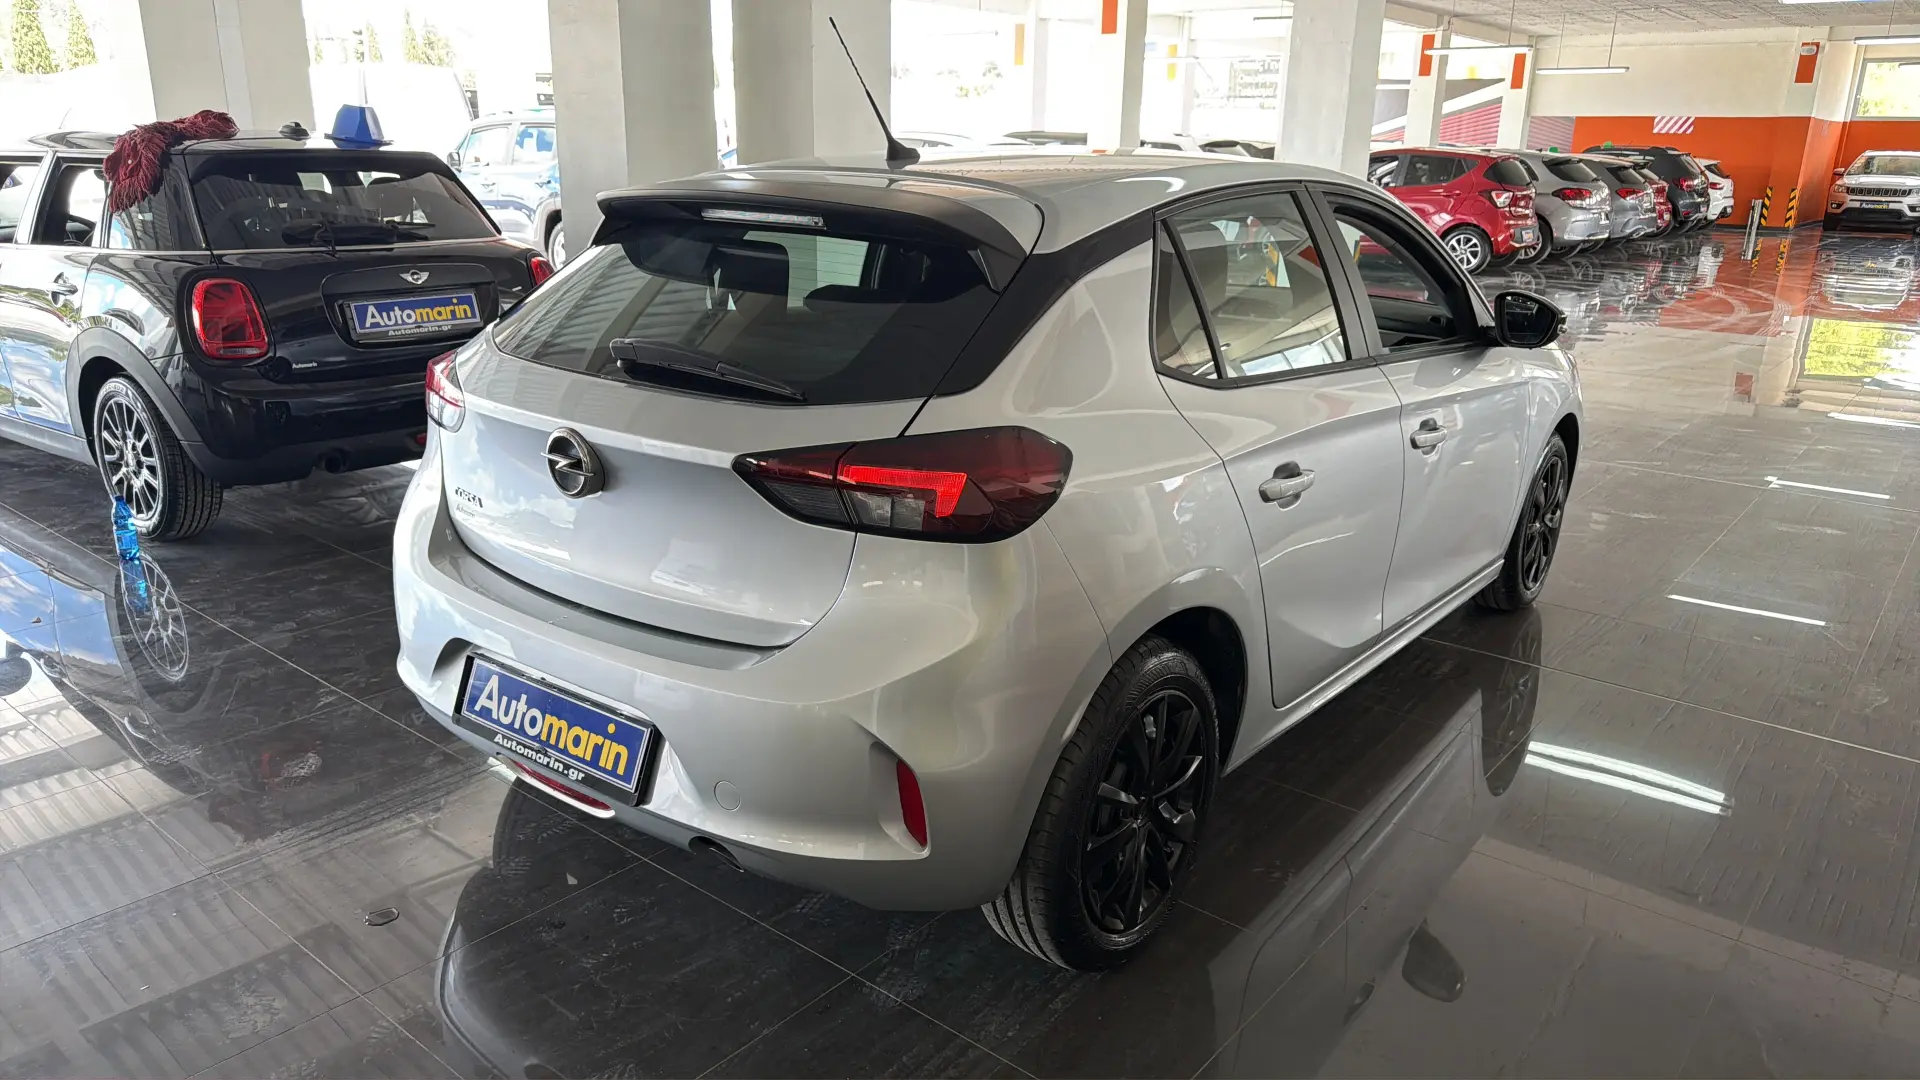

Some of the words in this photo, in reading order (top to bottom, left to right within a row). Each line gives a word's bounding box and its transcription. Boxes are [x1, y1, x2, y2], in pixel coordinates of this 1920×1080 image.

[365, 298, 472, 328] Automarin
[388, 325, 453, 336] Automarin.gr
[474, 674, 629, 776] Automarin
[493, 733, 586, 781] Automarin.gr
